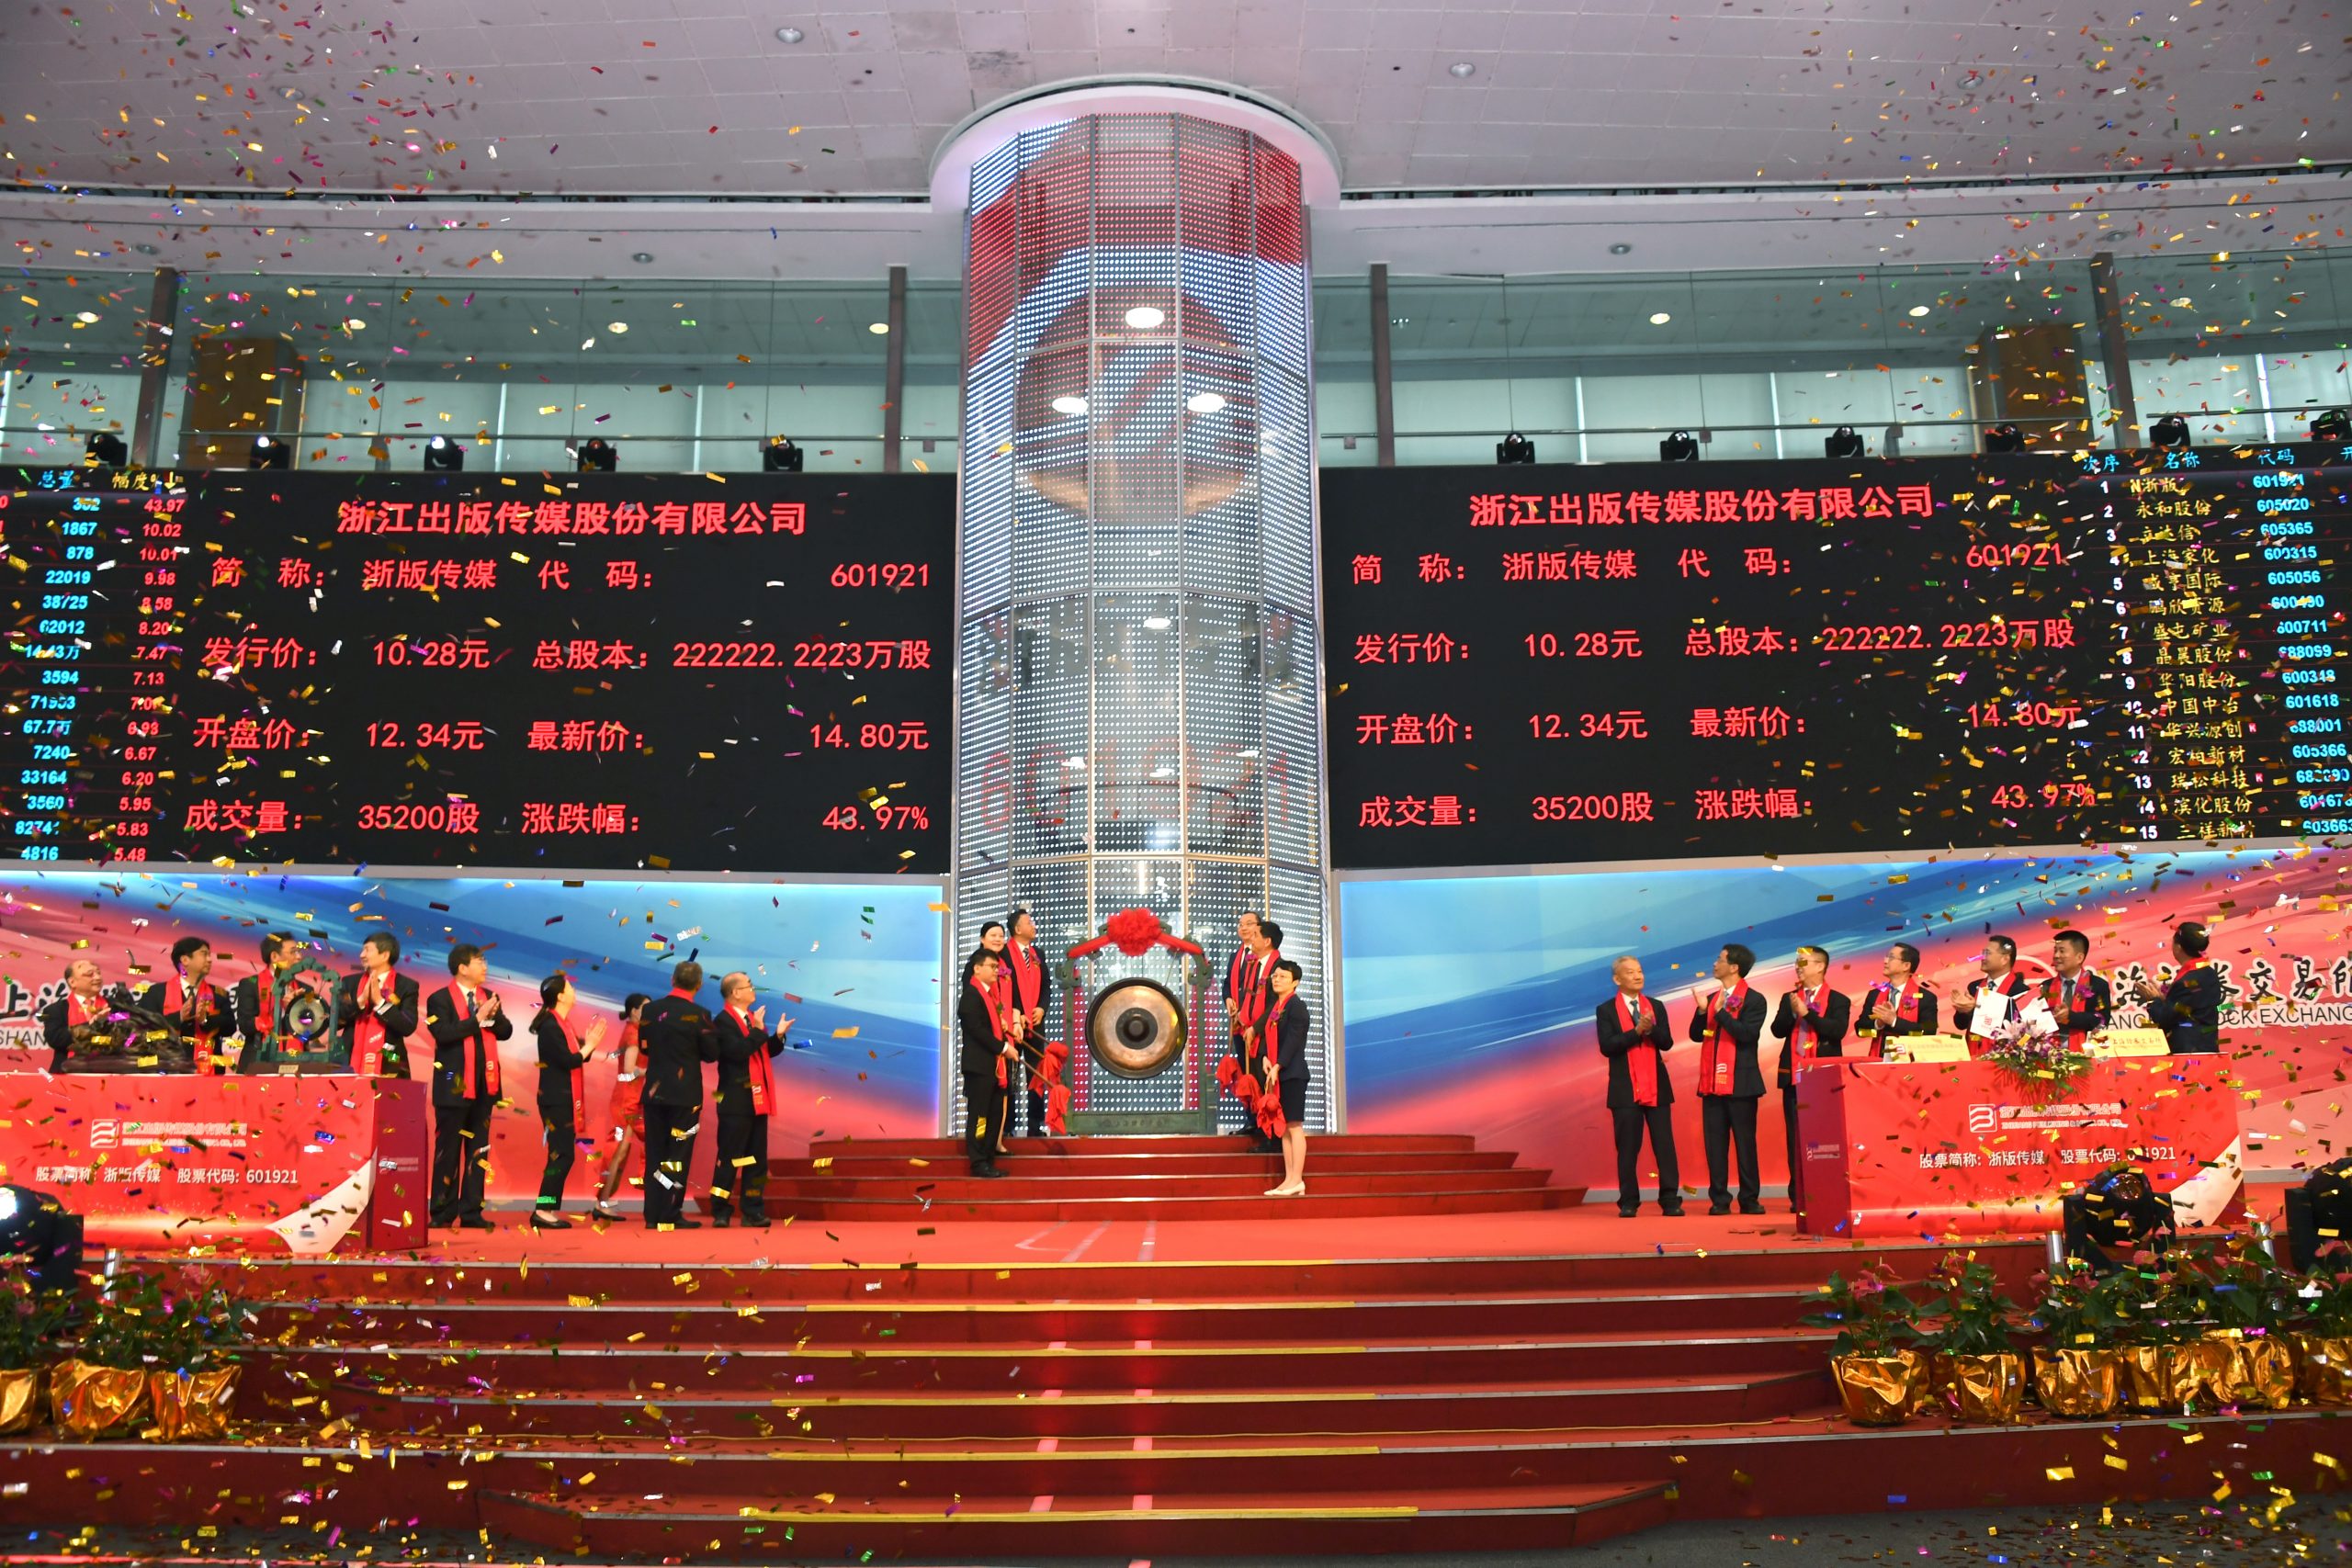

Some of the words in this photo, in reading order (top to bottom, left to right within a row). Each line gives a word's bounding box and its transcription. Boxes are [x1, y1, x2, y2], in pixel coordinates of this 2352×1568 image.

[2258, 448, 2295, 467] 代码
[2100, 480, 2109, 493] 1
[144, 499, 185, 513] 43.97
[1470, 485, 1934, 527] 浙江出版传媒股份有限公司
[2104, 505, 2113, 517] 2
[2257, 498, 2309, 512] 605020
[337, 501, 807, 536] 浙江出版传媒股份有限公司
[62, 522, 97, 536] 1867
[142, 524, 182, 537] 10.02
[2107, 529, 2116, 541] 3
[2261, 522, 2313, 536] 605365
[66, 546, 94, 559] 878
[140, 548, 177, 561] 10.01
[2109, 555, 2120, 566] 4
[2265, 546, 2317, 560] 600315
[1502, 549, 1637, 582] 浙版传媒
[1966, 542, 2063, 568] 601921
[45, 570, 91, 584] 22019
[144, 572, 175, 585] 9.98
[362, 559, 497, 589] 浙版传媒
[831, 563, 930, 587] 601921
[2113, 577, 2123, 590] 5
[2267, 570, 2321, 585] 605056
[141, 597, 173, 611] 858
[2116, 602, 2126, 615] 6
[40, 620, 85, 635] 62012
[139, 622, 170, 635] 8.20
[2120, 626, 2128, 639] 7
[2277, 619, 2327, 634] 600711
[137, 646, 168, 660] 7.47
[1354, 632, 1470, 664] 发行价：
[1524, 629, 1643, 659] 10.28元
[1684, 626, 1800, 657] 总股本：
[201, 637, 317, 668] 发行价：
[373, 640, 490, 669] 10.28元
[532, 639, 647, 670] 总股本：
[673, 640, 931, 670] 222222.2223万股
[2122, 651, 2132, 665] 8
[42, 671, 79, 684] 3594
[133, 671, 164, 685] 7.13
[2125, 676, 2135, 690] 9
[130, 696, 163, 710] 7.0
[2125, 701, 2143, 714] 10
[2286, 694, 2339, 708] 601618
[1355, 713, 1473, 745] 开盘价：
[1528, 710, 1648, 740] 12.34元
[1690, 706, 1807, 739] 最新价：
[2128, 726, 2144, 739] 11
[367, 721, 484, 750] 12.34元
[527, 720, 644, 751] 最新价：
[810, 721, 929, 750] 14.80元
[33, 745, 70, 759] 7240
[124, 747, 156, 761] 6.67
[21, 770, 67, 784] 33164
[121, 772, 153, 785] 6.20
[2134, 775, 2152, 789] 13
[28, 795, 64, 810] 3560
[119, 796, 152, 811] 5.95
[1359, 795, 1477, 828] 成交量：
[1532, 792, 1654, 823] 35200股
[1694, 788, 1812, 821] 涨跌幅：
[186, 799, 302, 832] 成交量：
[358, 803, 480, 833] 35200股
[520, 802, 639, 834] 涨跌幅：
[822, 806, 929, 830] 43.97%
[117, 822, 149, 836] 5.83
[2140, 826, 2158, 840] 15
[21, 846, 59, 860] 4816
[114, 847, 146, 862] 5.48
[176, 1168, 240, 1184] 股票代码：
[246, 1168, 299, 1184] 601921
